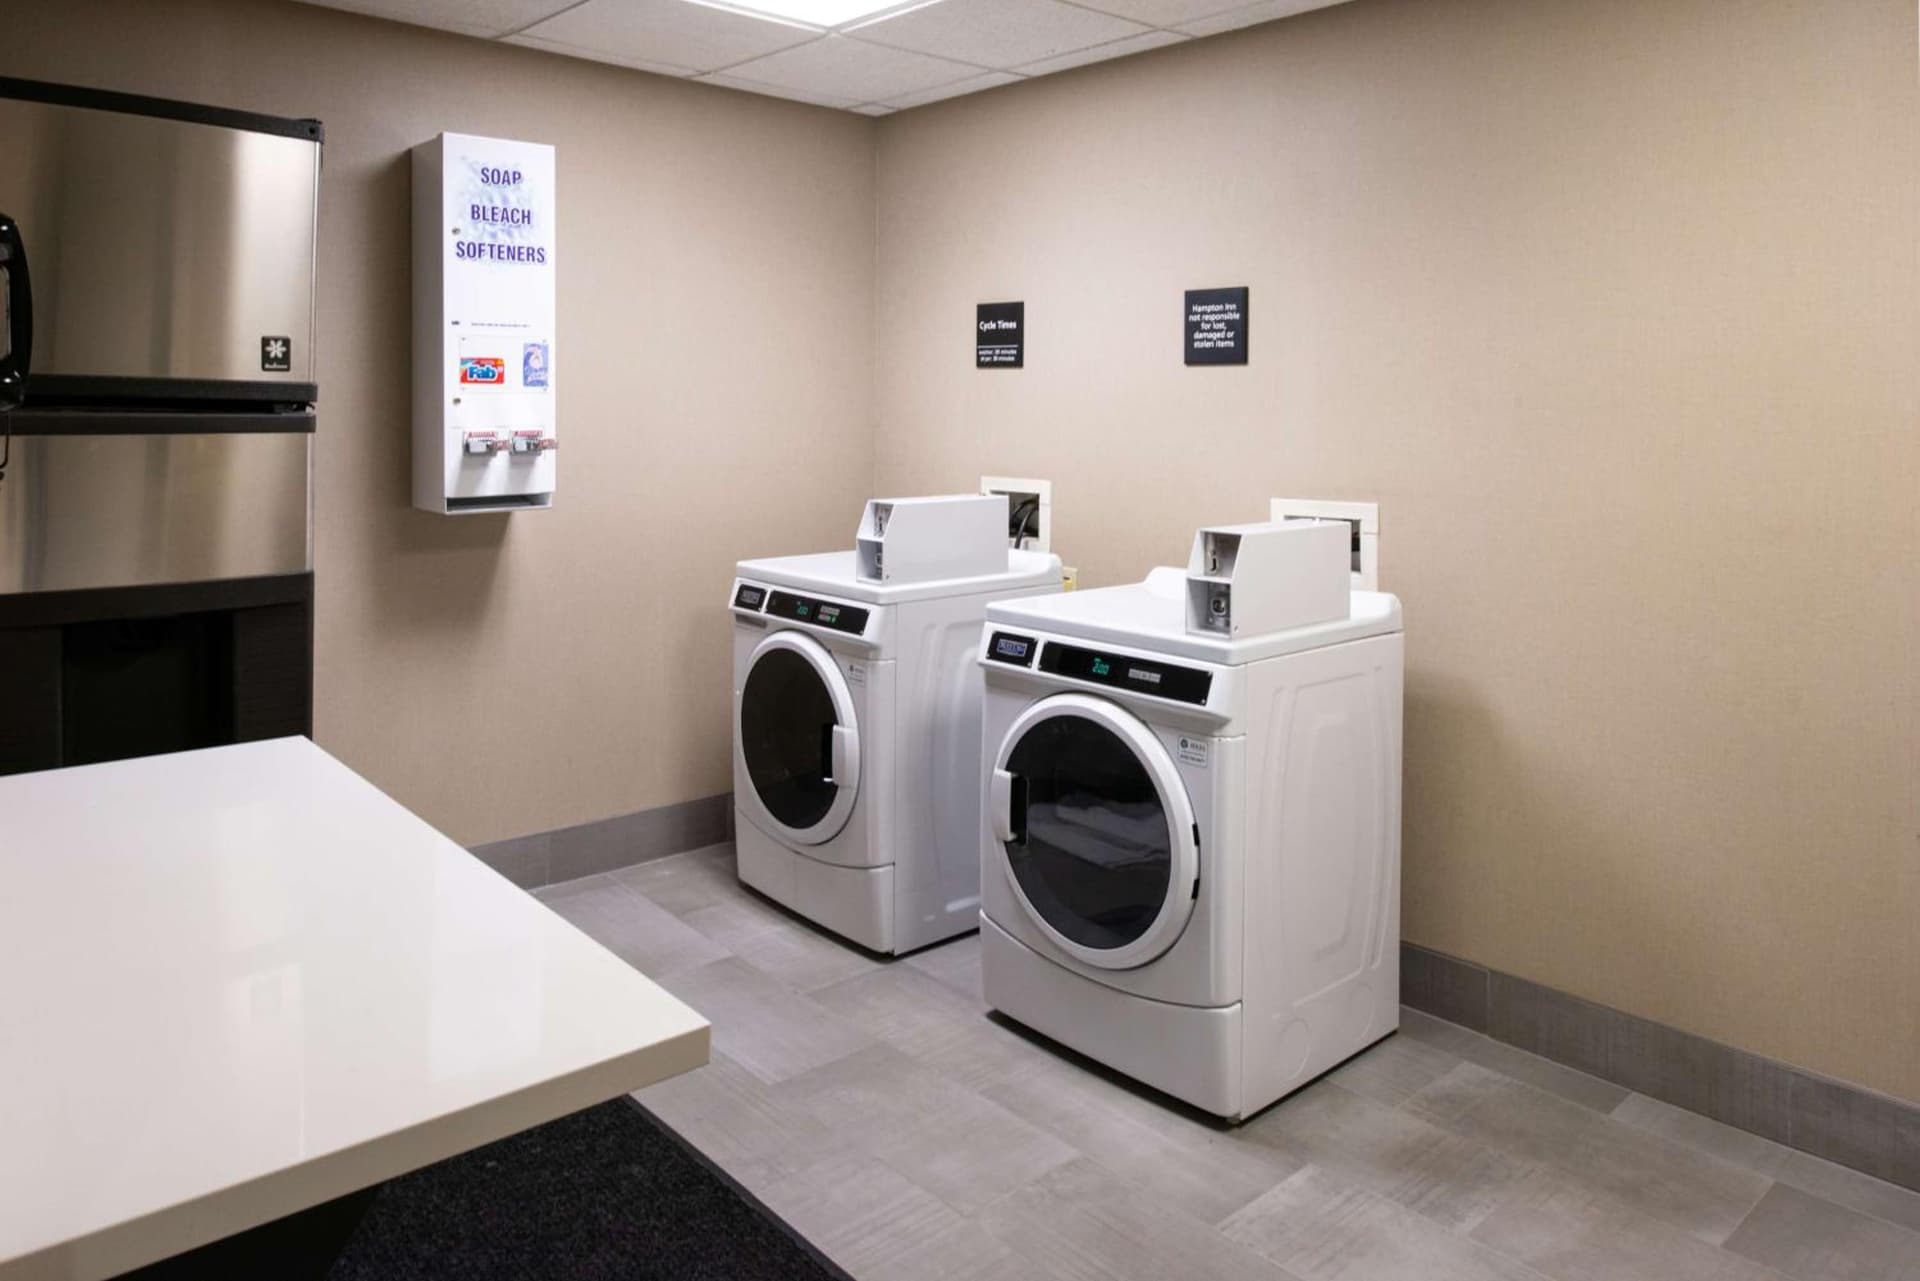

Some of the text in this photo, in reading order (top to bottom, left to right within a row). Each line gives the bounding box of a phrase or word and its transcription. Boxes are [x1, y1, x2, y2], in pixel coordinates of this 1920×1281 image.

[480, 166, 522, 186] SOAP
[471, 204, 531, 225] BLEACH
[456, 240, 545, 263] SOFTENERS
[1192, 303, 1237, 313] Hampton Inn
[1188, 312, 1240, 322] not responsible
[979, 320, 1017, 332] Cycle Times
[1201, 322, 1227, 330] for lost,
[1193, 331, 1225, 340] damaged
[1194, 340, 1234, 348] stolen items
[467, 365, 497, 380] Fab
